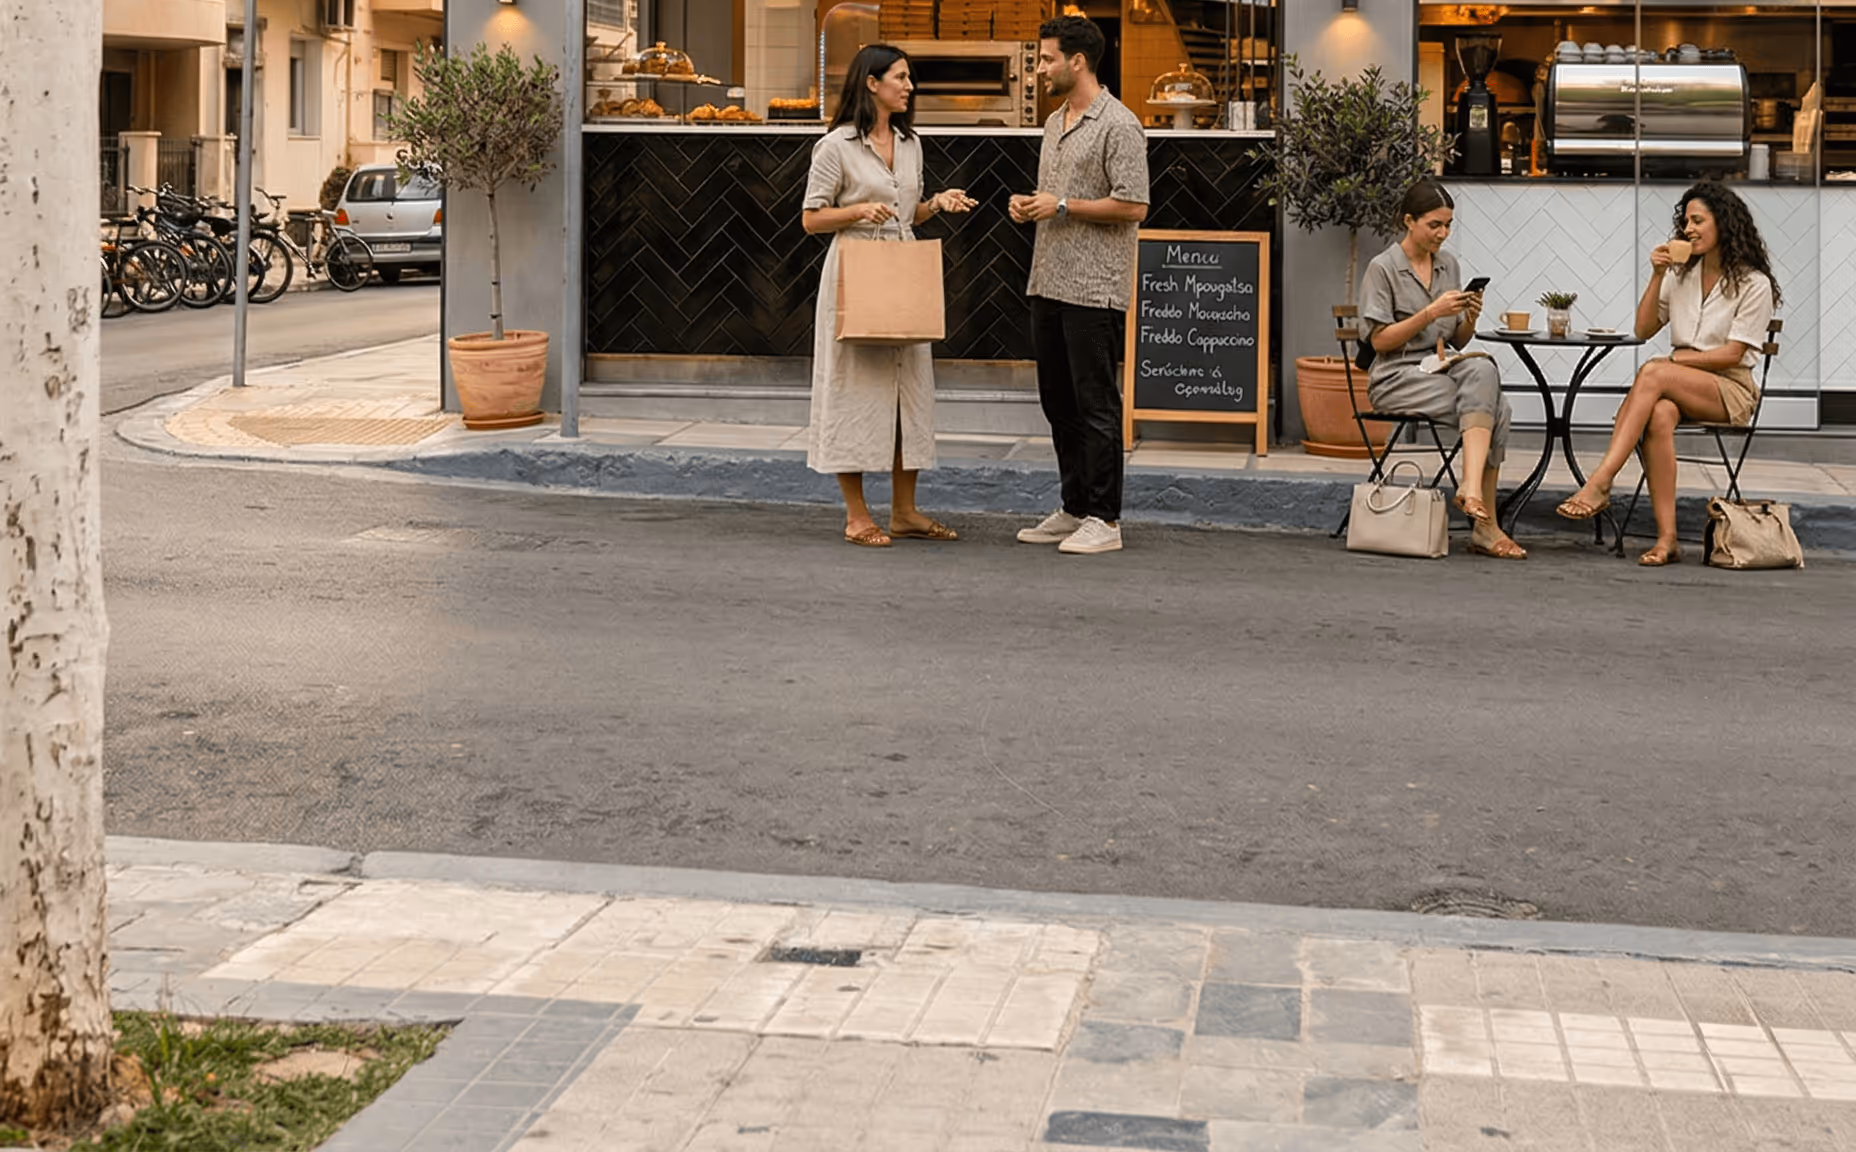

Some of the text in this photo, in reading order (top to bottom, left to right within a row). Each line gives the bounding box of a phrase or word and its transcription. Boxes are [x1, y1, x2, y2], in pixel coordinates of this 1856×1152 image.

[1142, 273, 1179, 292] Fresh
[1141, 300, 1183, 318] Freddo
[1141, 326, 1183, 344] Freddo
